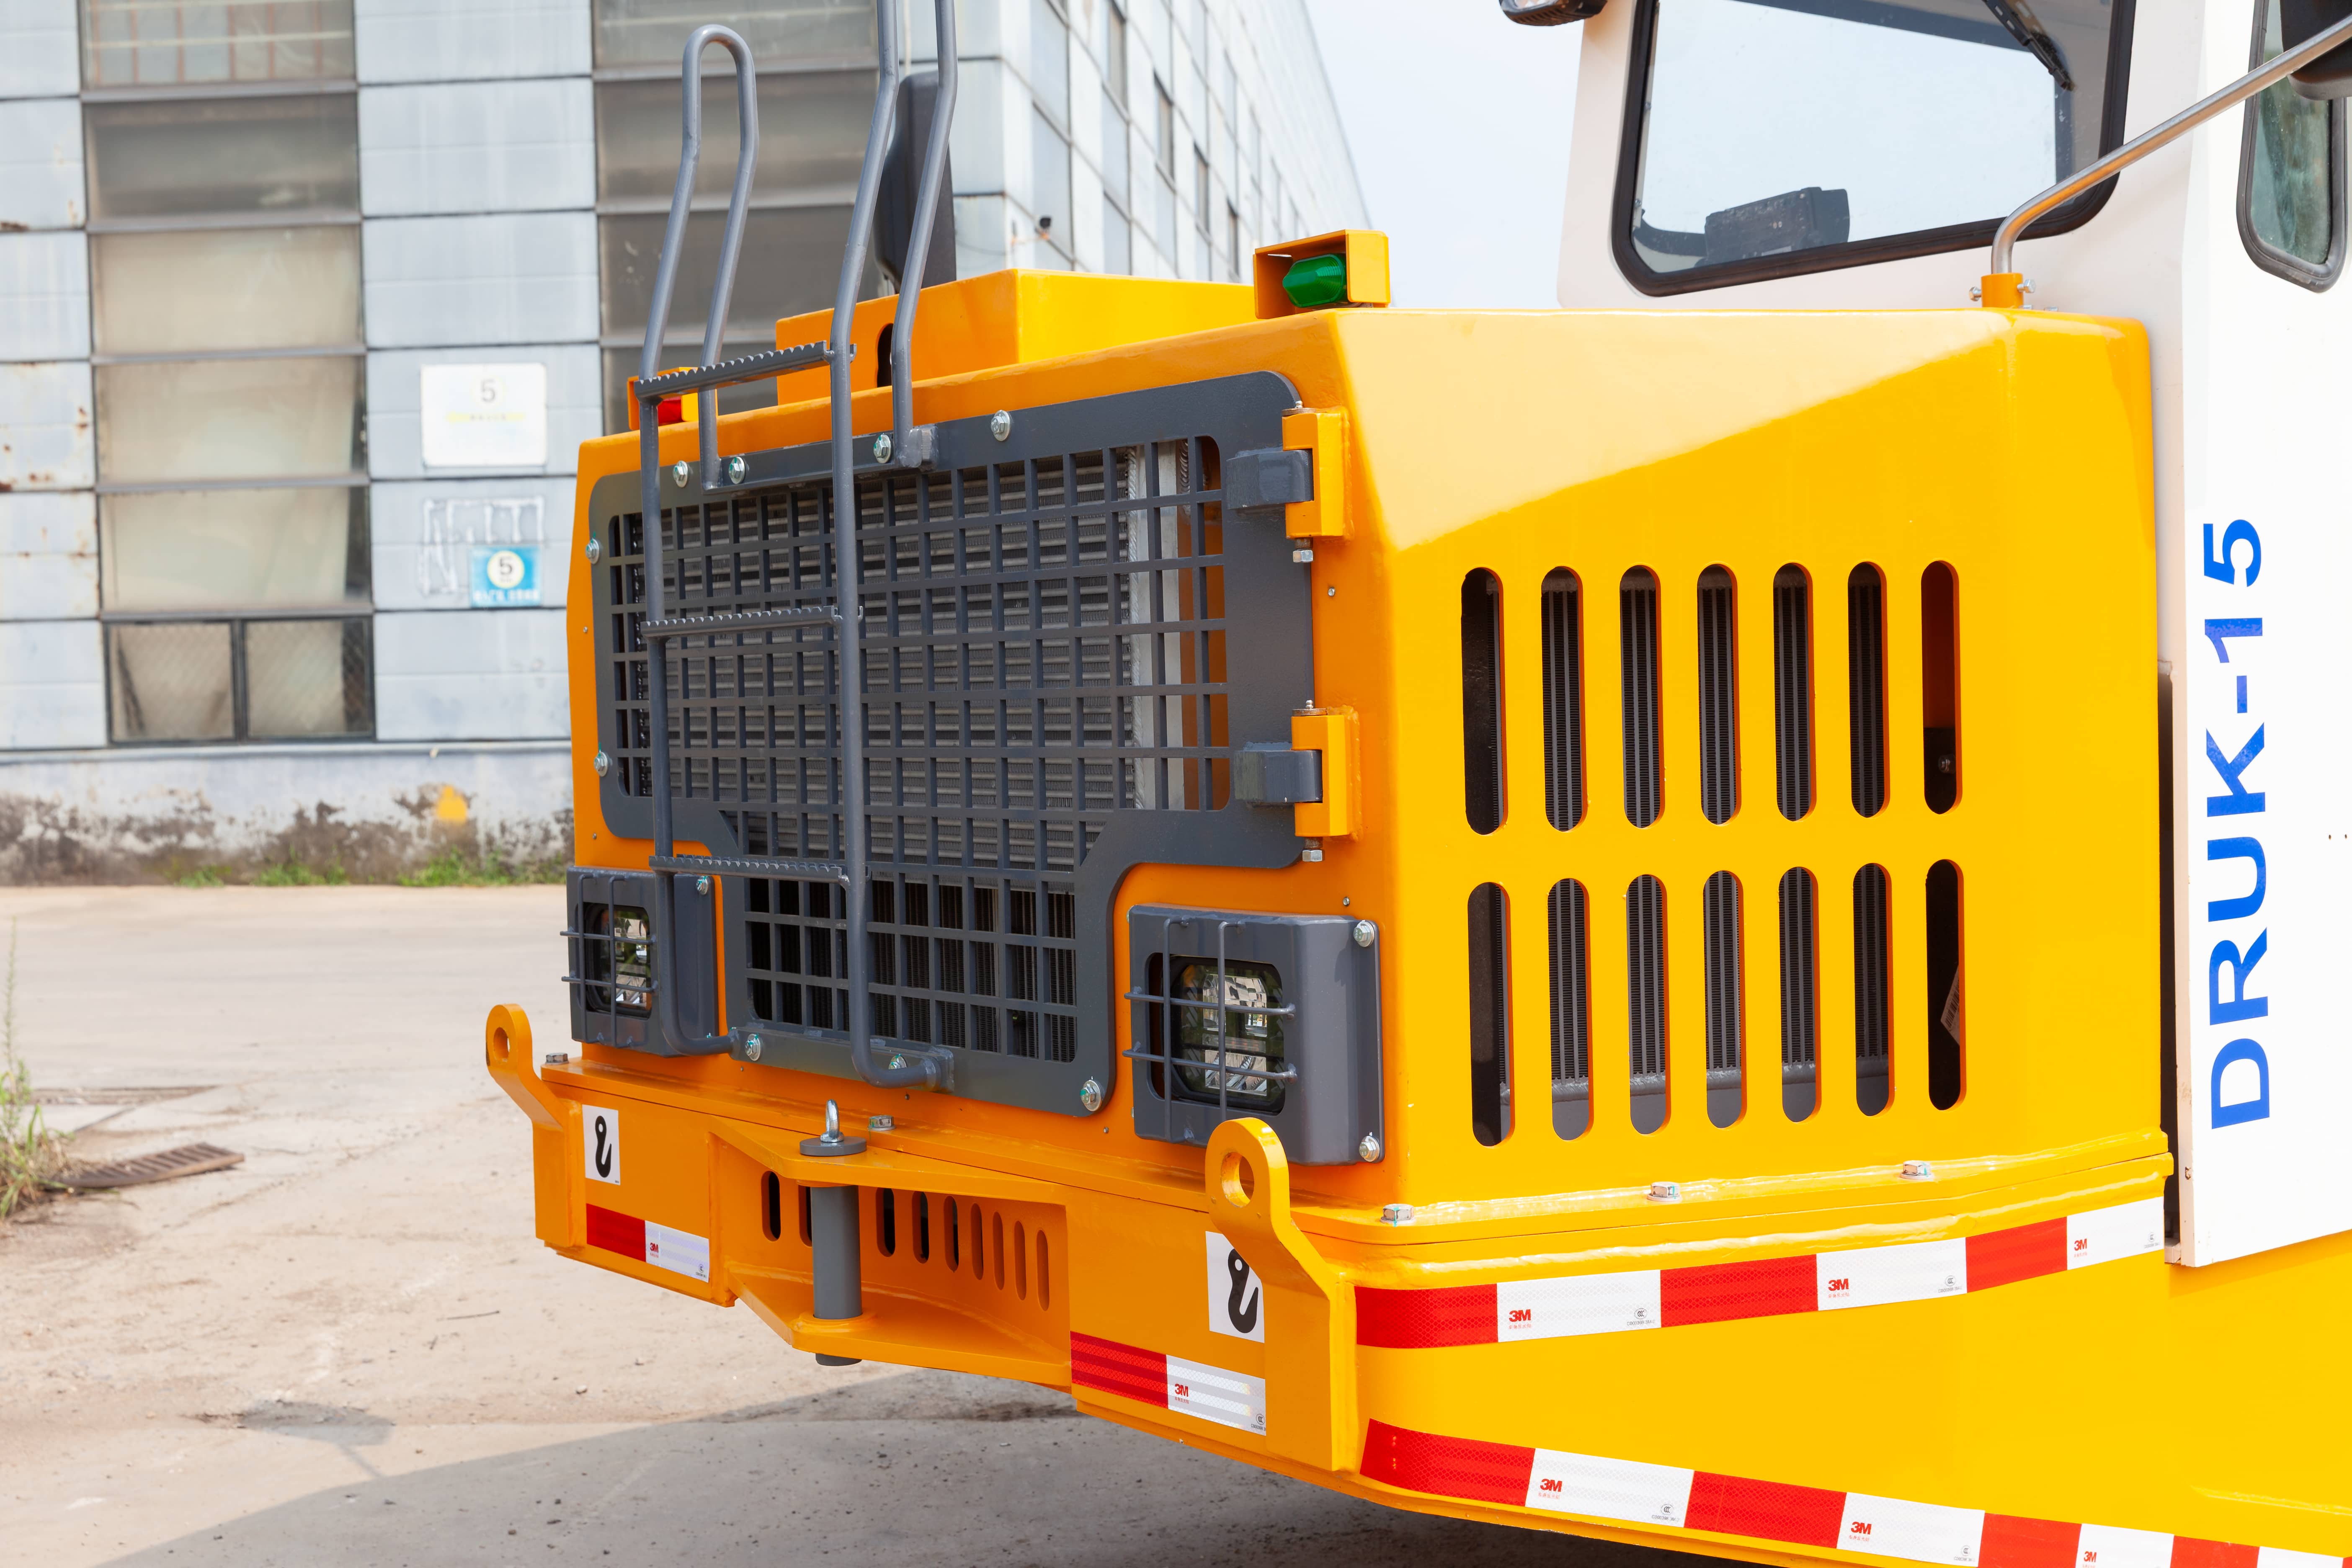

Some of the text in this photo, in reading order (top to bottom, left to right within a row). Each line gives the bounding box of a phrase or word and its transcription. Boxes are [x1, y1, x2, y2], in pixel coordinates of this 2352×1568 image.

[481, 379, 496, 402] 5
[500, 556, 513, 575] 5
[2204, 519, 2270, 1129] DRUK-15
[650, 1242, 659, 1253] 3M
[2074, 1238, 2087, 1251] 3M
[1828, 1278, 1849, 1291] 3M
[1509, 1309, 1531, 1322] 3M
[1175, 1383, 1189, 1398] 3M
[1540, 1478, 1563, 1492] 3M
[1851, 1522, 1872, 1535] 3M
[2084, 1551, 2097, 1563] 3M
